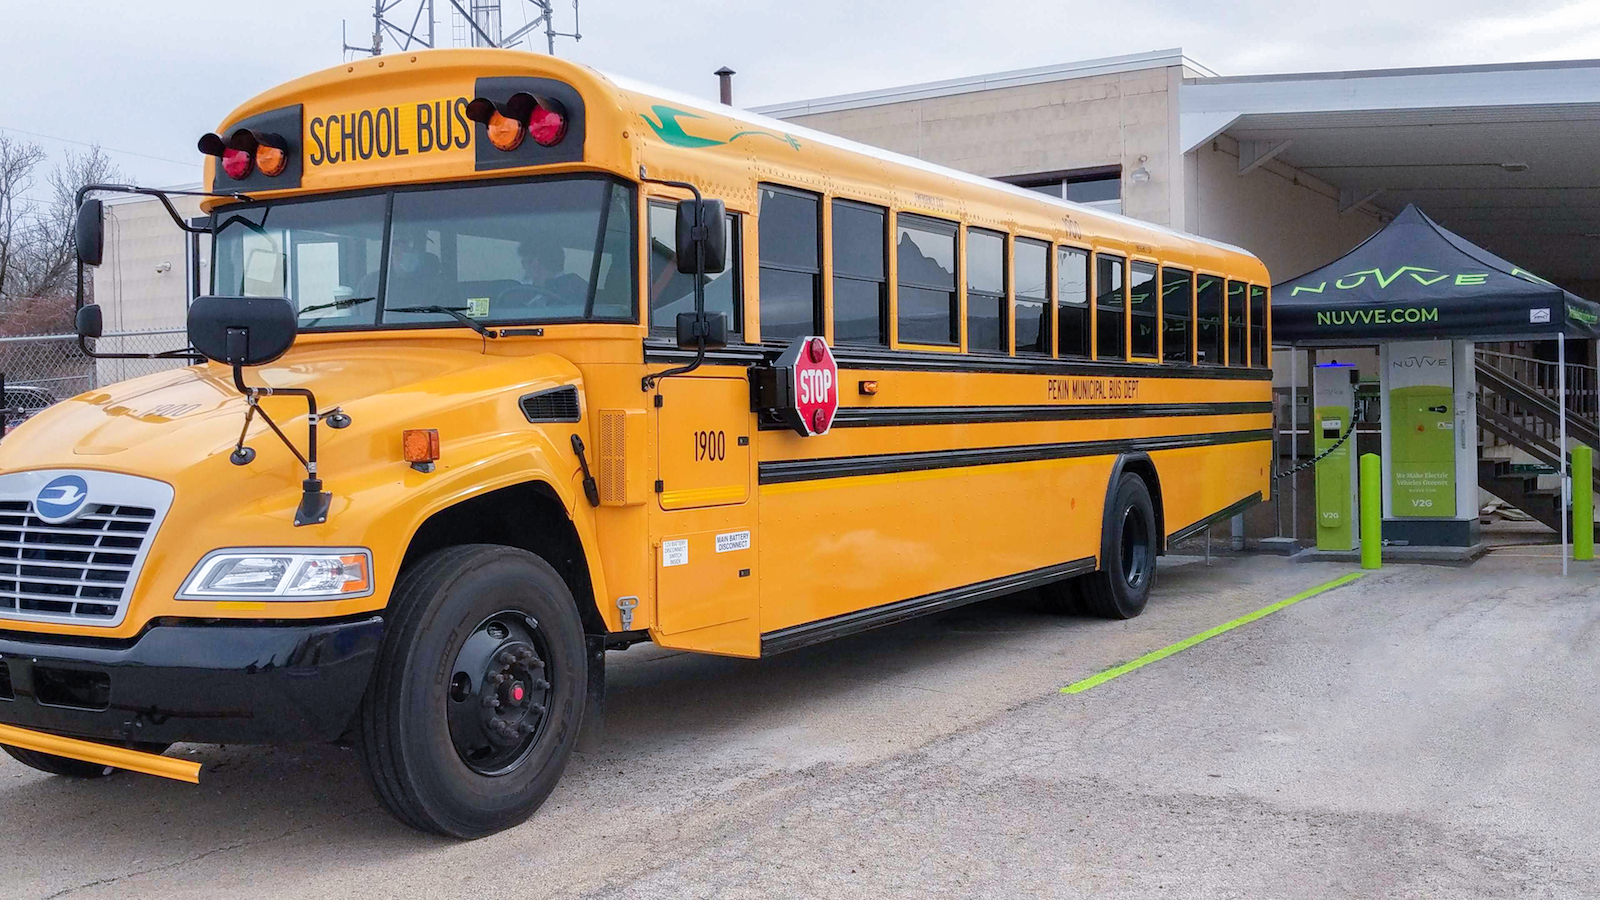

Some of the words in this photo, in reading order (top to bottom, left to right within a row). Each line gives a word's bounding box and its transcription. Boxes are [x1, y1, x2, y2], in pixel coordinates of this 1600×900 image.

[310, 107, 409, 166] SCHOOL
[417, 97, 471, 154] BUS
[1317, 308, 1439, 326] NUVVE.COM
[1393, 356, 1447, 368] NUVVE
[800, 369, 832, 404] STOP
[1048, 379, 1069, 400] PEKIN
[1072, 379, 1106, 400] MUNICIPAL
[1109, 380, 1122, 399] BUS
[1124, 380, 1139, 399] DEPT
[694, 430, 725, 462] 1900
[1411, 499, 1433, 507] V2G
[718, 541, 747, 551] DISCONNECT
[729, 533, 749, 542] BATTERY
